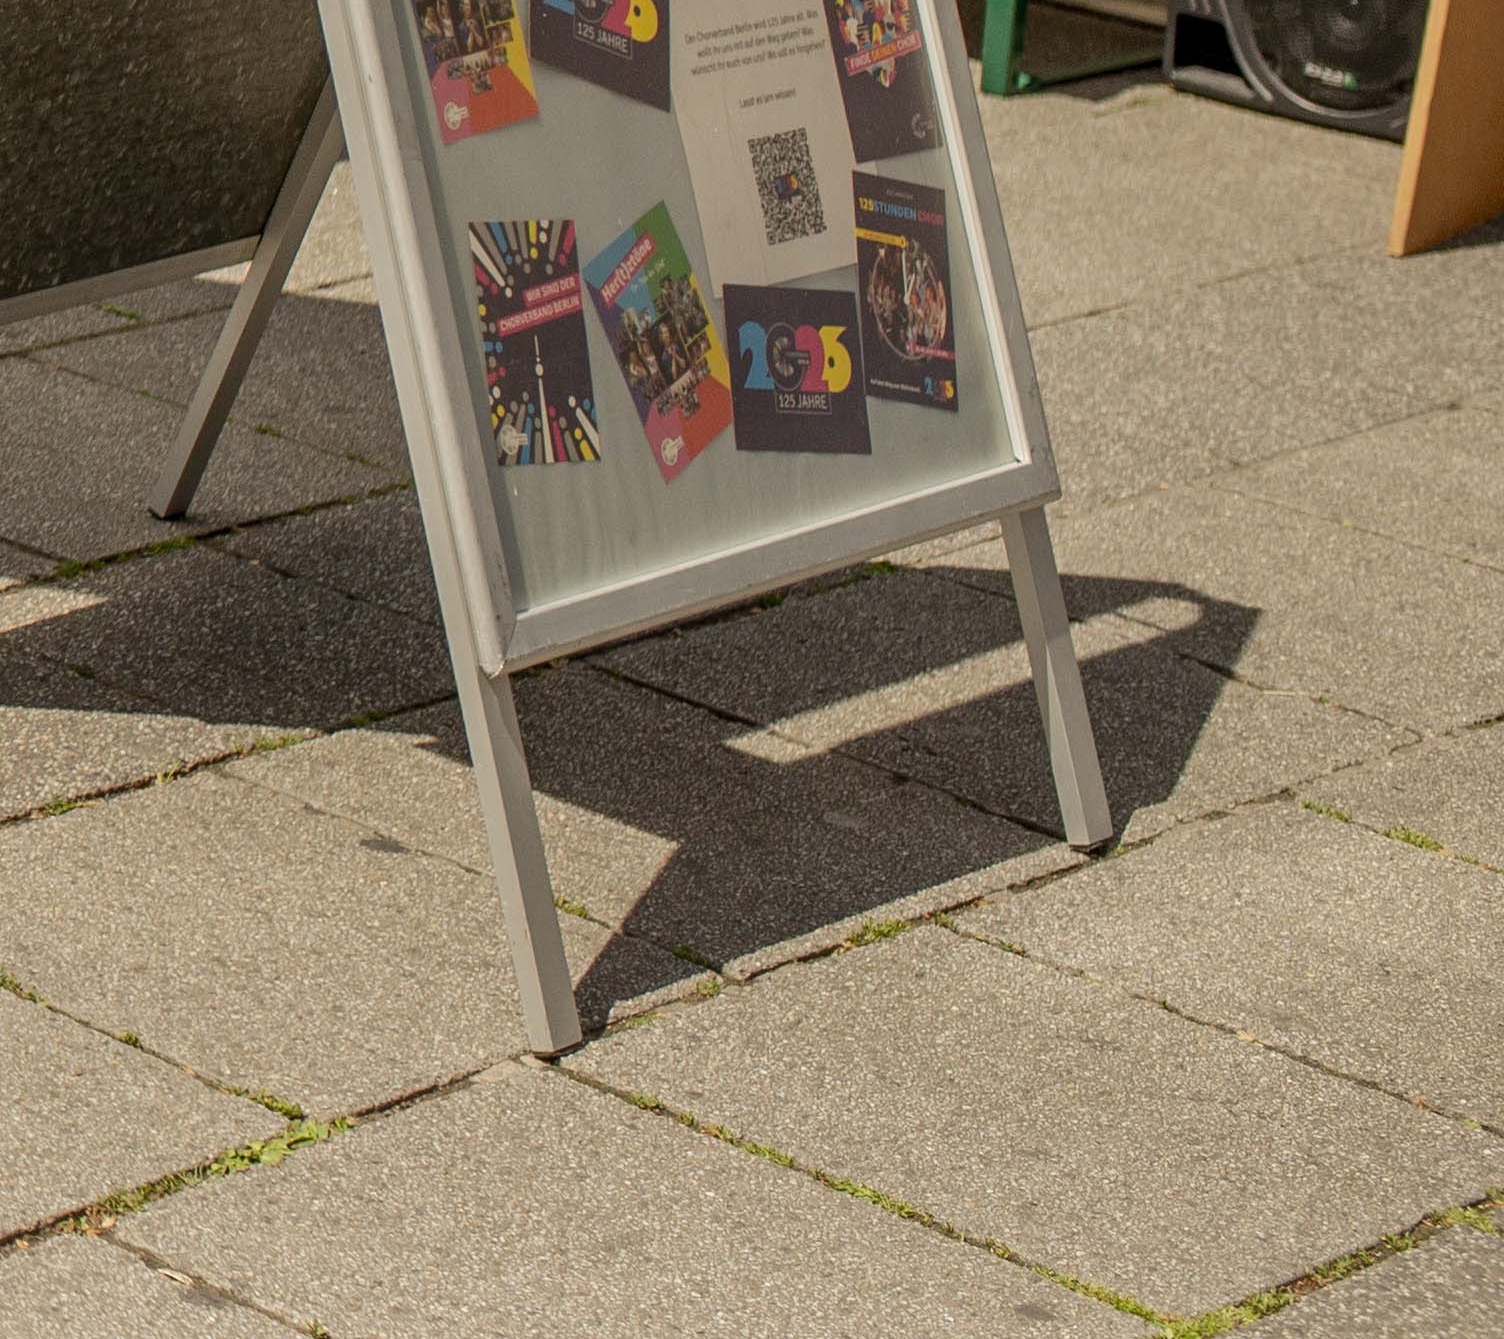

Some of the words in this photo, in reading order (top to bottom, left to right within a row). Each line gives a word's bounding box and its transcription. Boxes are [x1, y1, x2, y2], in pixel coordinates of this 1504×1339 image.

[578, 22, 595, 40] 125
[596, 29, 628, 53] JAHRE
[601, 238, 652, 303] Her(t)ztöne
[738, 320, 852, 393] 2025
[779, 394, 796, 409] 125
[798, 393, 828, 410] JAHRE
